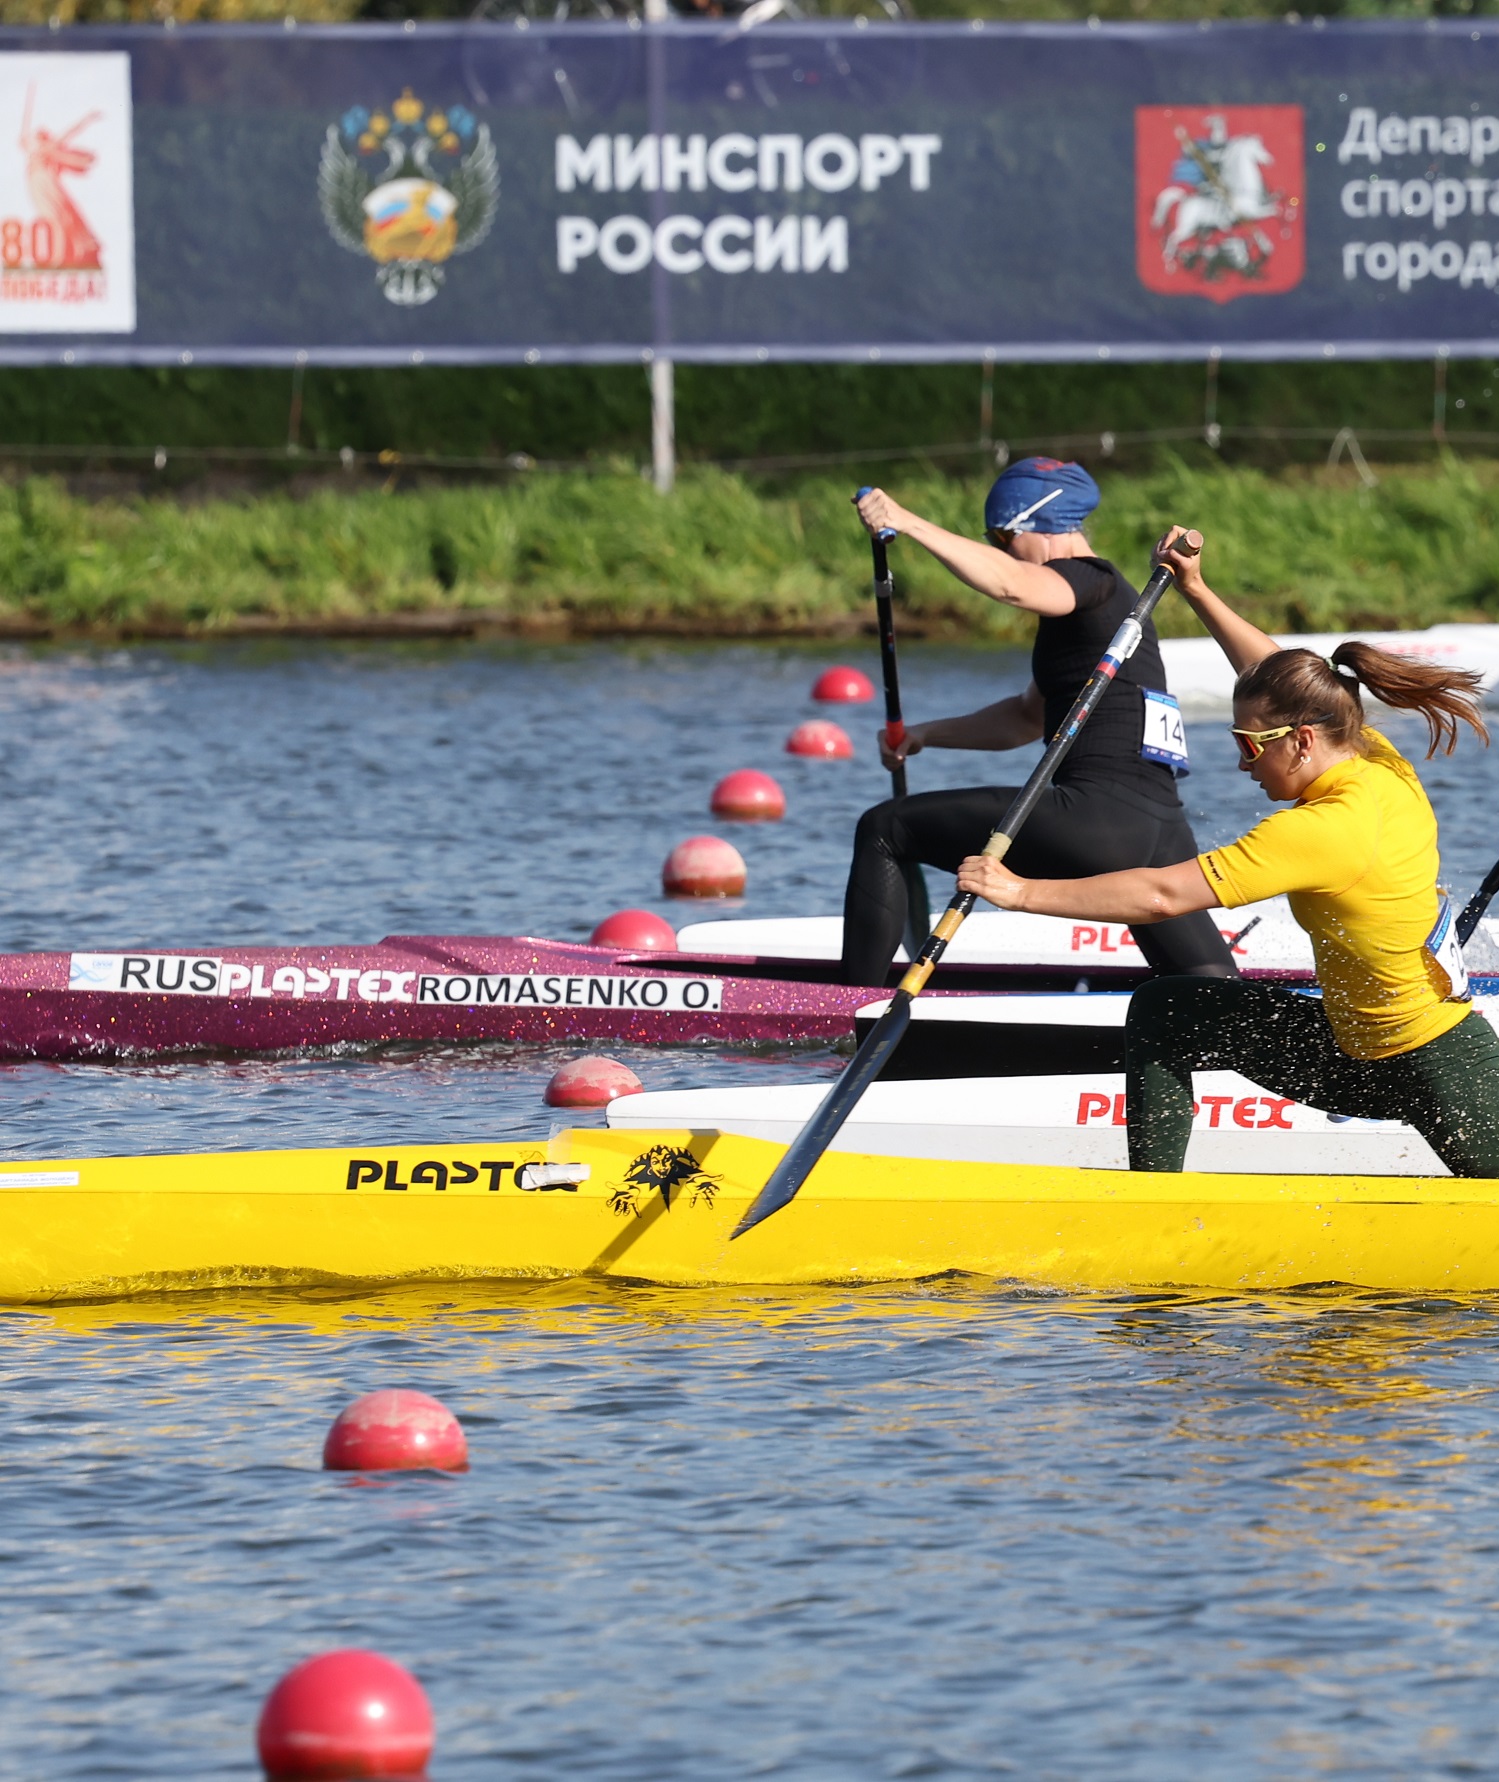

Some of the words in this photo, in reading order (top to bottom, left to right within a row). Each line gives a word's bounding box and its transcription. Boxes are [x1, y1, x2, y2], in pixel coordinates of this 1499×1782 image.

[556, 133, 941, 192] МИНСПОРТ
[2, 218, 53, 270] 80
[557, 214, 848, 274] РОССИИ
[1160, 713, 1183, 746] 14
[120, 957, 218, 992] RUS
[220, 963, 417, 1003] PLASTEX
[418, 976, 668, 1007] ROMASENKO
[681, 981, 719, 1011] O.
[1076, 1092, 1296, 1130] PLTEX
